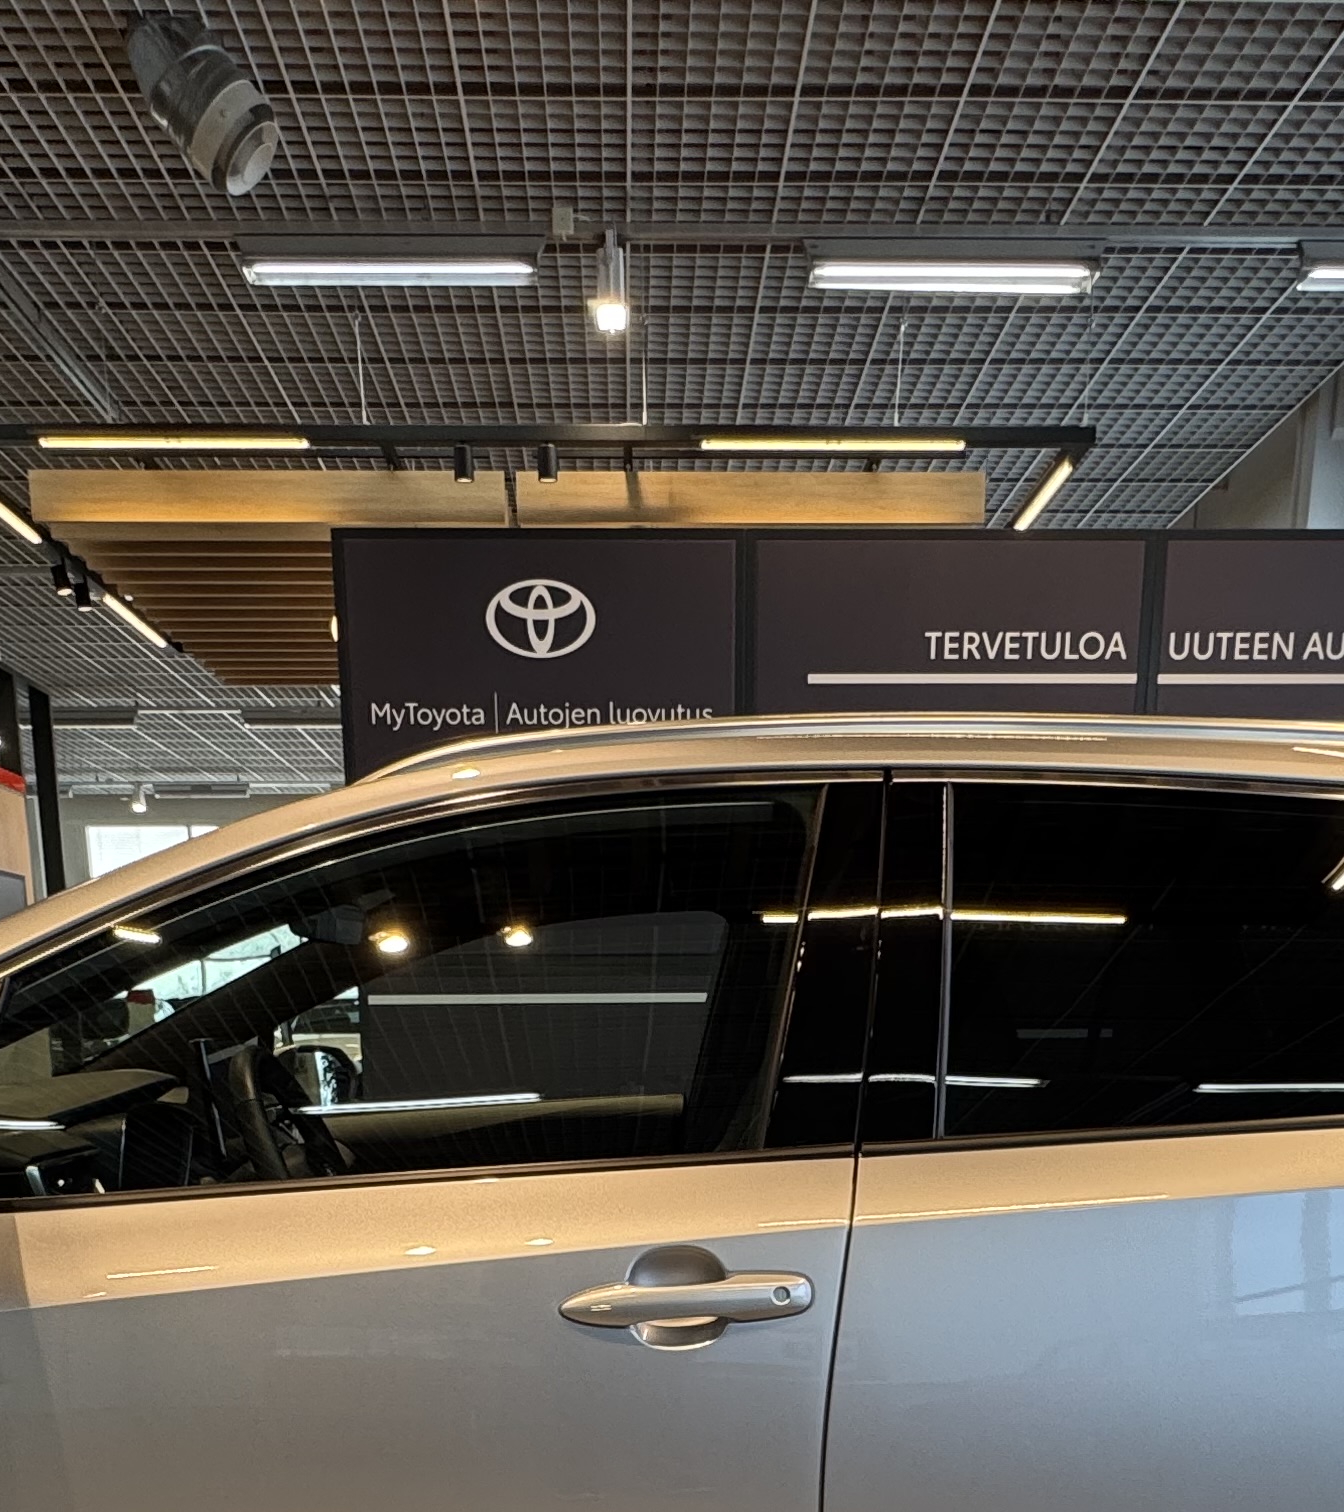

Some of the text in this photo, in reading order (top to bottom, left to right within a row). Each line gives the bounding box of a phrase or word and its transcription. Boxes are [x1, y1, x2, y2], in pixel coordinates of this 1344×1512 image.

[924, 631, 1127, 660] TERVETULOA
[1168, 631, 1295, 660] UUTEEN
[371, 701, 713, 731] MyToyota Autojen luovutus
